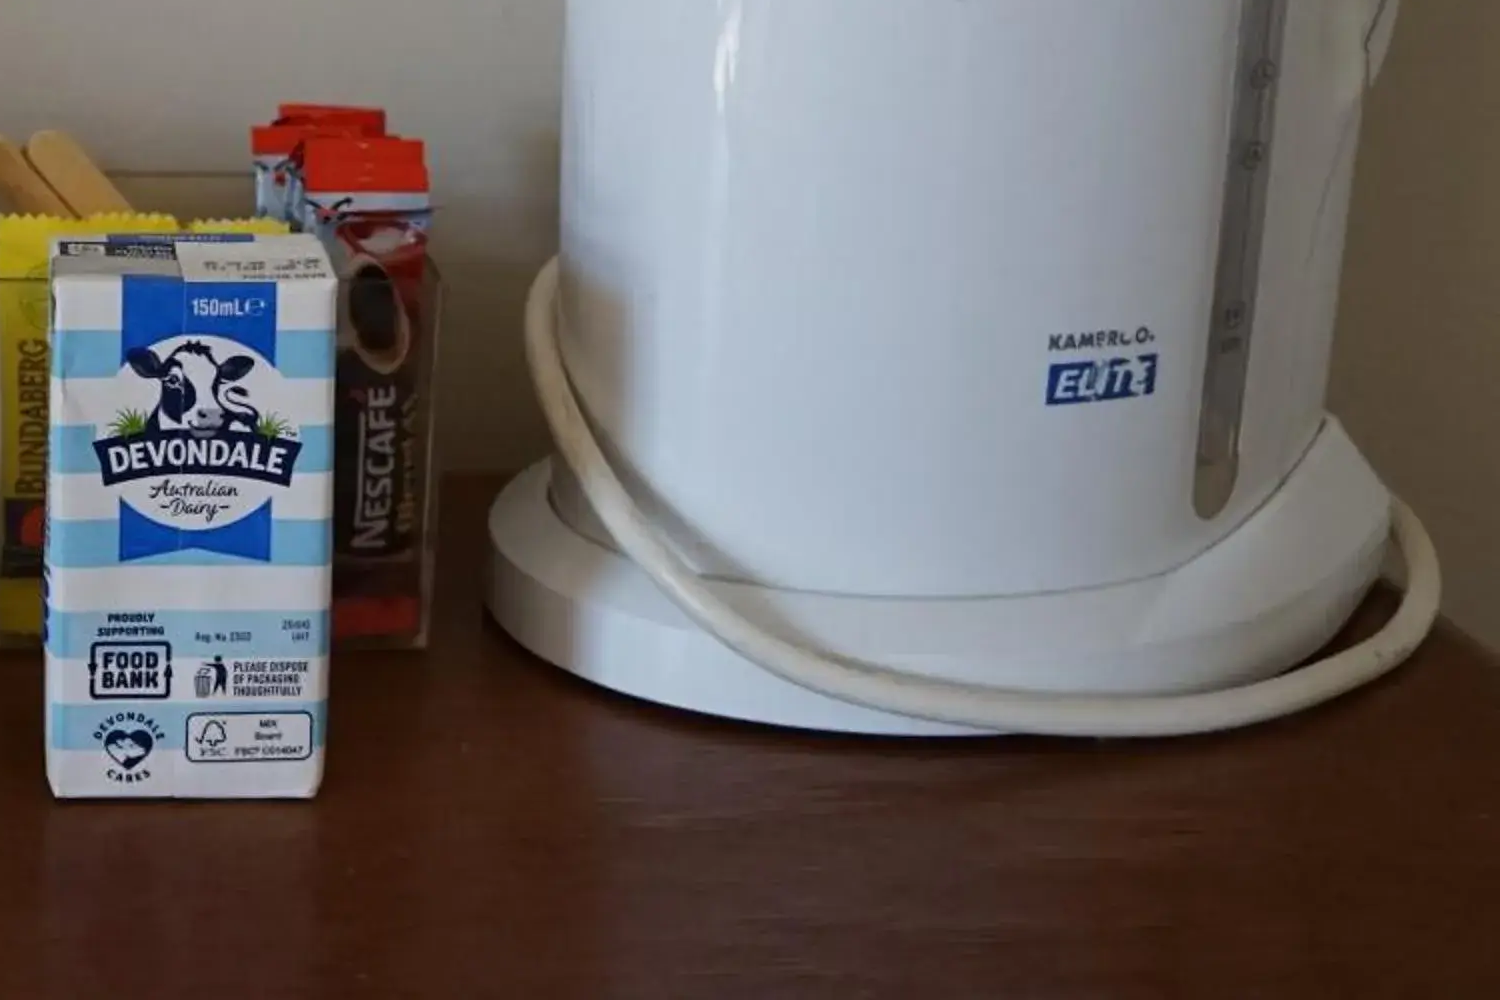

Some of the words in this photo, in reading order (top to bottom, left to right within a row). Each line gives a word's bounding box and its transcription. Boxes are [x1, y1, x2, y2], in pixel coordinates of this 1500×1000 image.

[14, 337, 48, 495] BUNDABERG
[107, 437, 288, 475] DEVONDALE
[149, 478, 239, 499] Australian
[107, 612, 155, 623] PROUDLY
[96, 626, 165, 637] SUPPORTING
[102, 651, 159, 669] FOOD
[233, 661, 268, 672] PLEASE
[270, 661, 309, 672] DISPOSE
[102, 671, 159, 689] BANK
[233, 673, 244, 684] OF
[247, 673, 300, 684] PACKAGING
[233, 685, 302, 697] THOUGHTFULLY
[93, 711, 166, 740] DEVONDALE
[106, 768, 151, 782] CARES
